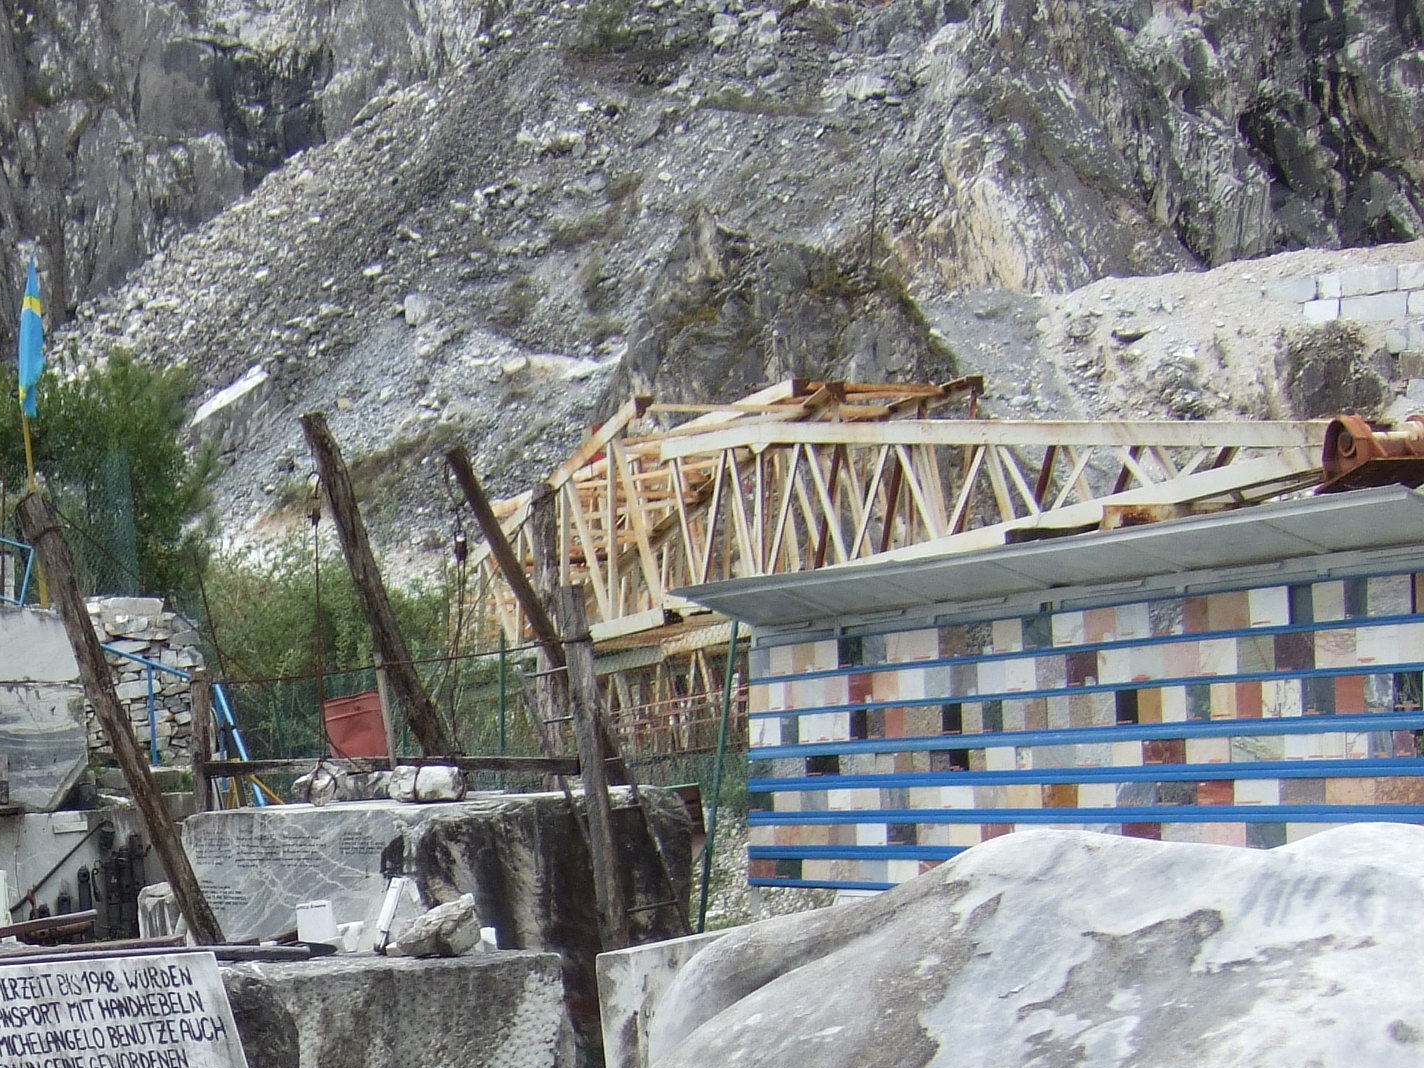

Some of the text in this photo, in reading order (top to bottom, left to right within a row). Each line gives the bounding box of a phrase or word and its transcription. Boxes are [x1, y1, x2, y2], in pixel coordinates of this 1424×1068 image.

[81, 971, 119, 993] 1948
[123, 965, 193, 989] WURDEN
[68, 999, 94, 1023] MIT
[98, 990, 204, 1020] HANDHEBELN
[107, 1020, 180, 1048] BENUTZE
[180, 1016, 228, 1042] AUCH
